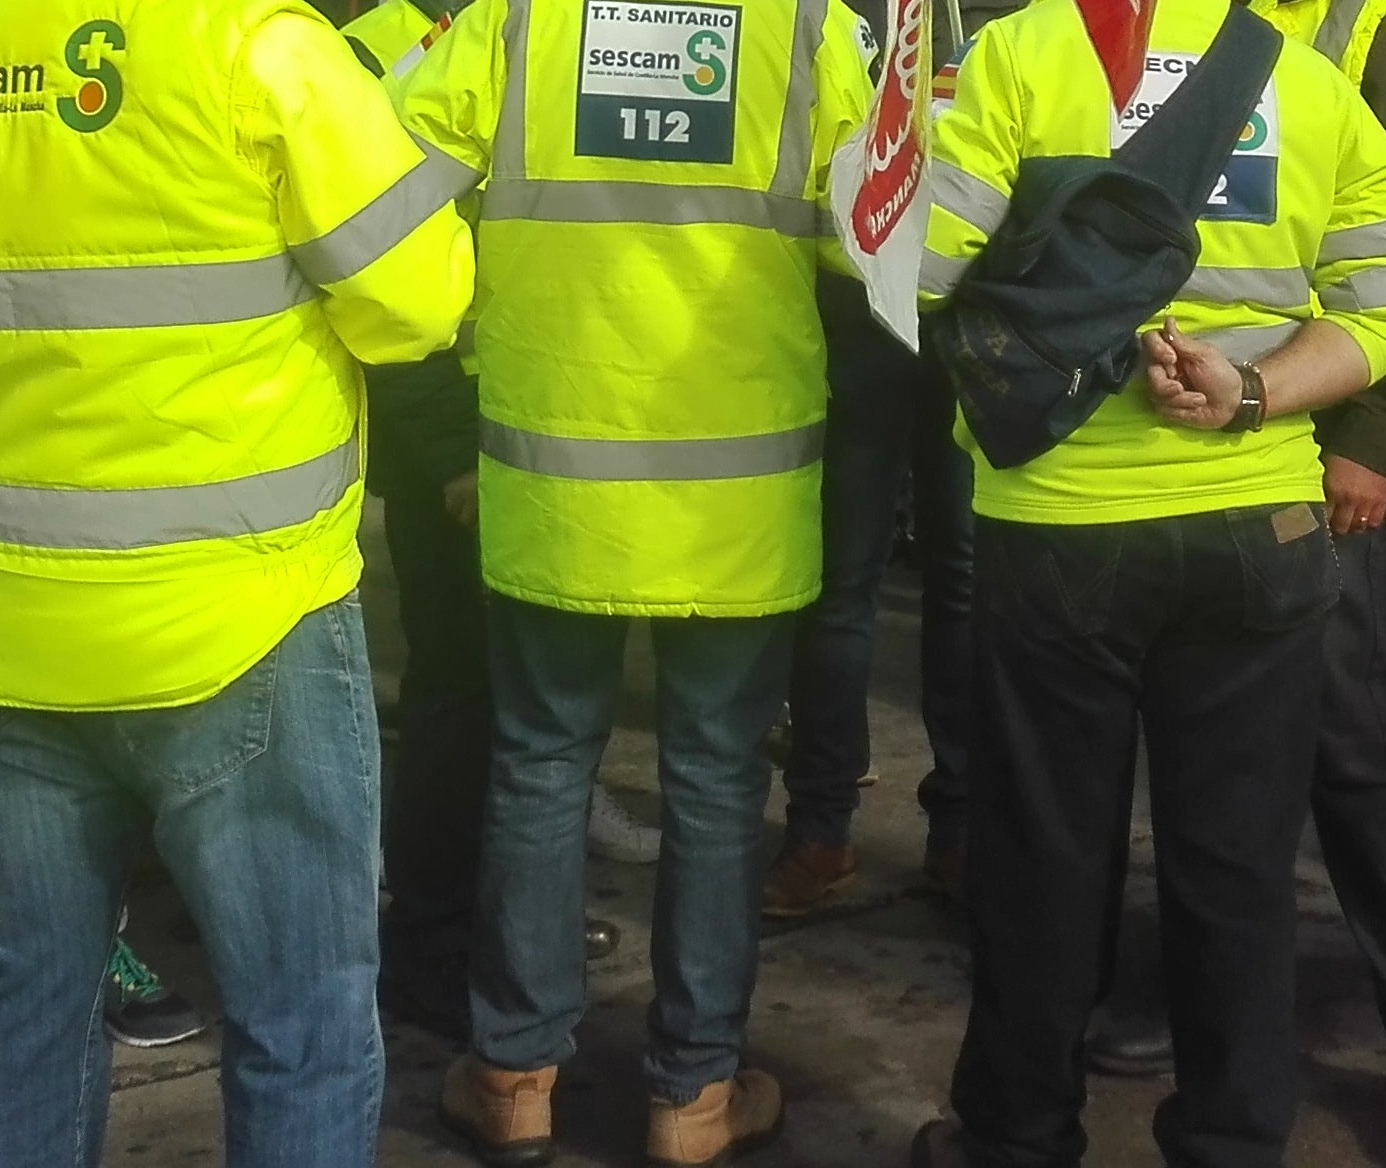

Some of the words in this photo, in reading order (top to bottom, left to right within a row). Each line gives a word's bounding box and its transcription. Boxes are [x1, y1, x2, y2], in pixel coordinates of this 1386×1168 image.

[591, 6, 621, 21] T.T.
[627, 8, 733, 28] SANITARIO
[589, 48, 681, 70] sescam
[620, 107, 691, 143] 112
